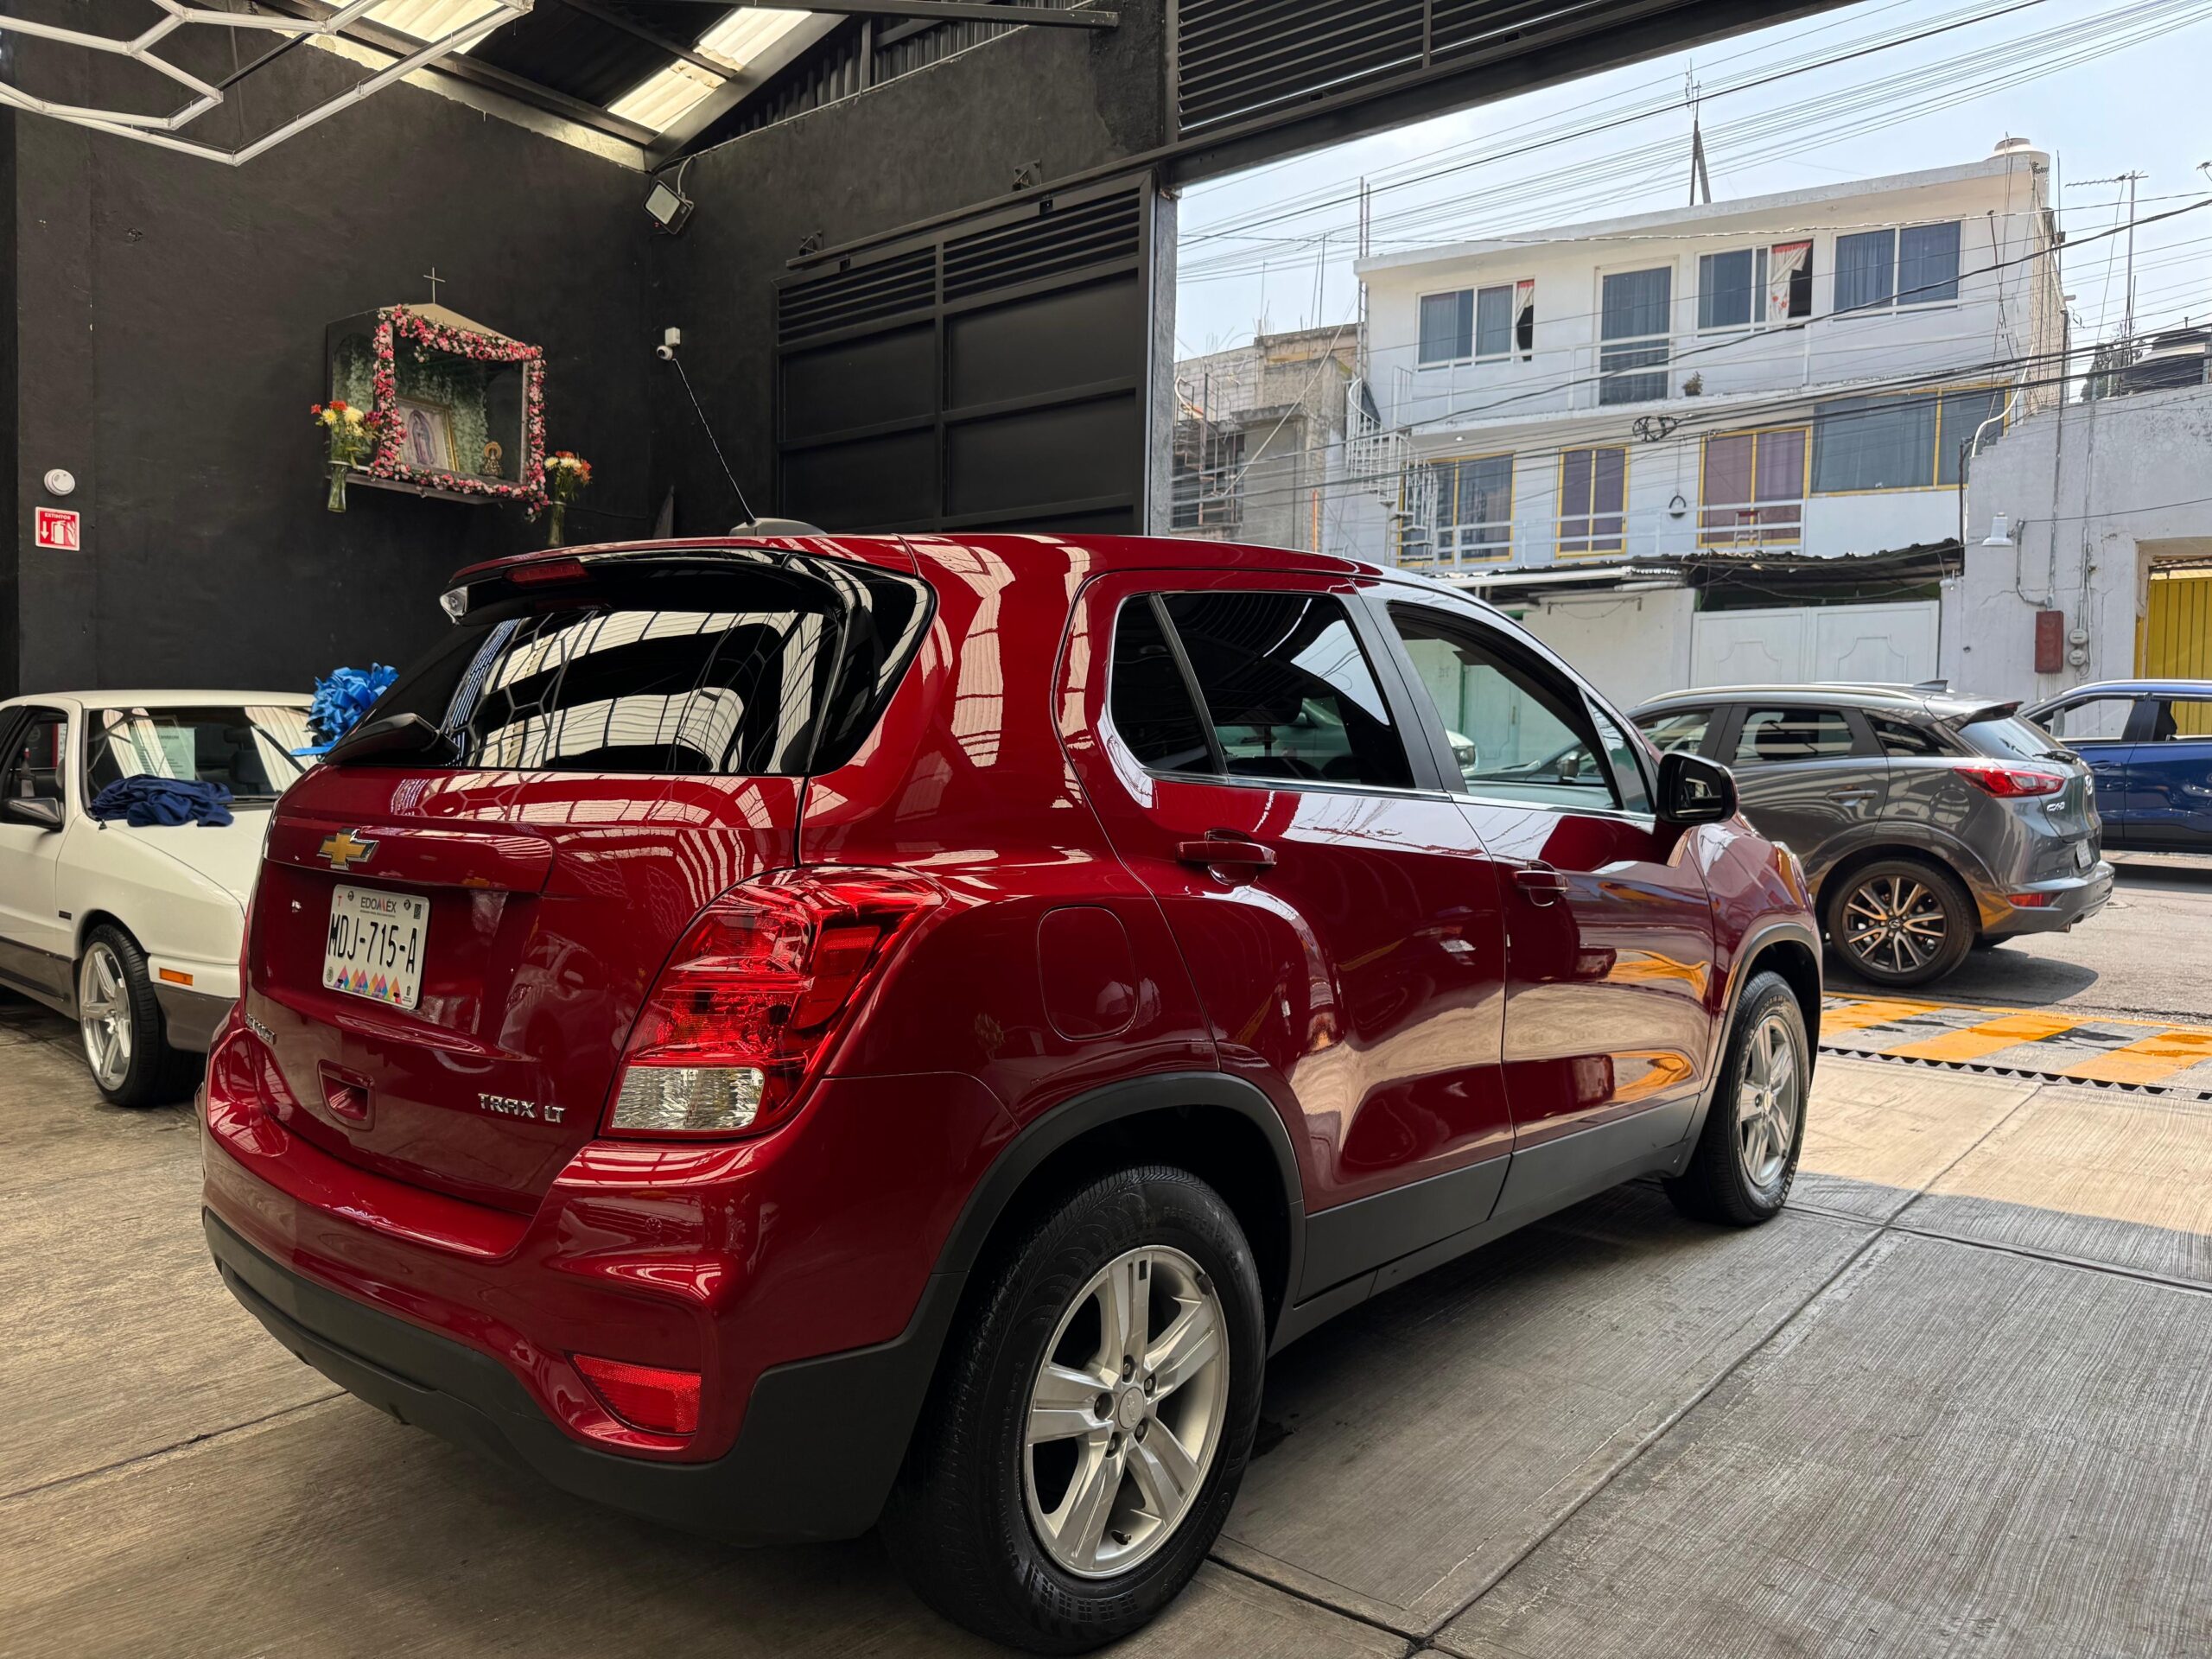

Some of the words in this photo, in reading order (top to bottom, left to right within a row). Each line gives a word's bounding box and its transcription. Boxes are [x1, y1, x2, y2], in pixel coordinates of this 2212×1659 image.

[327, 912, 417, 975] MDJ-715-A
[478, 1092, 537, 1119] TRAX
[544, 1105, 567, 1123] LT
